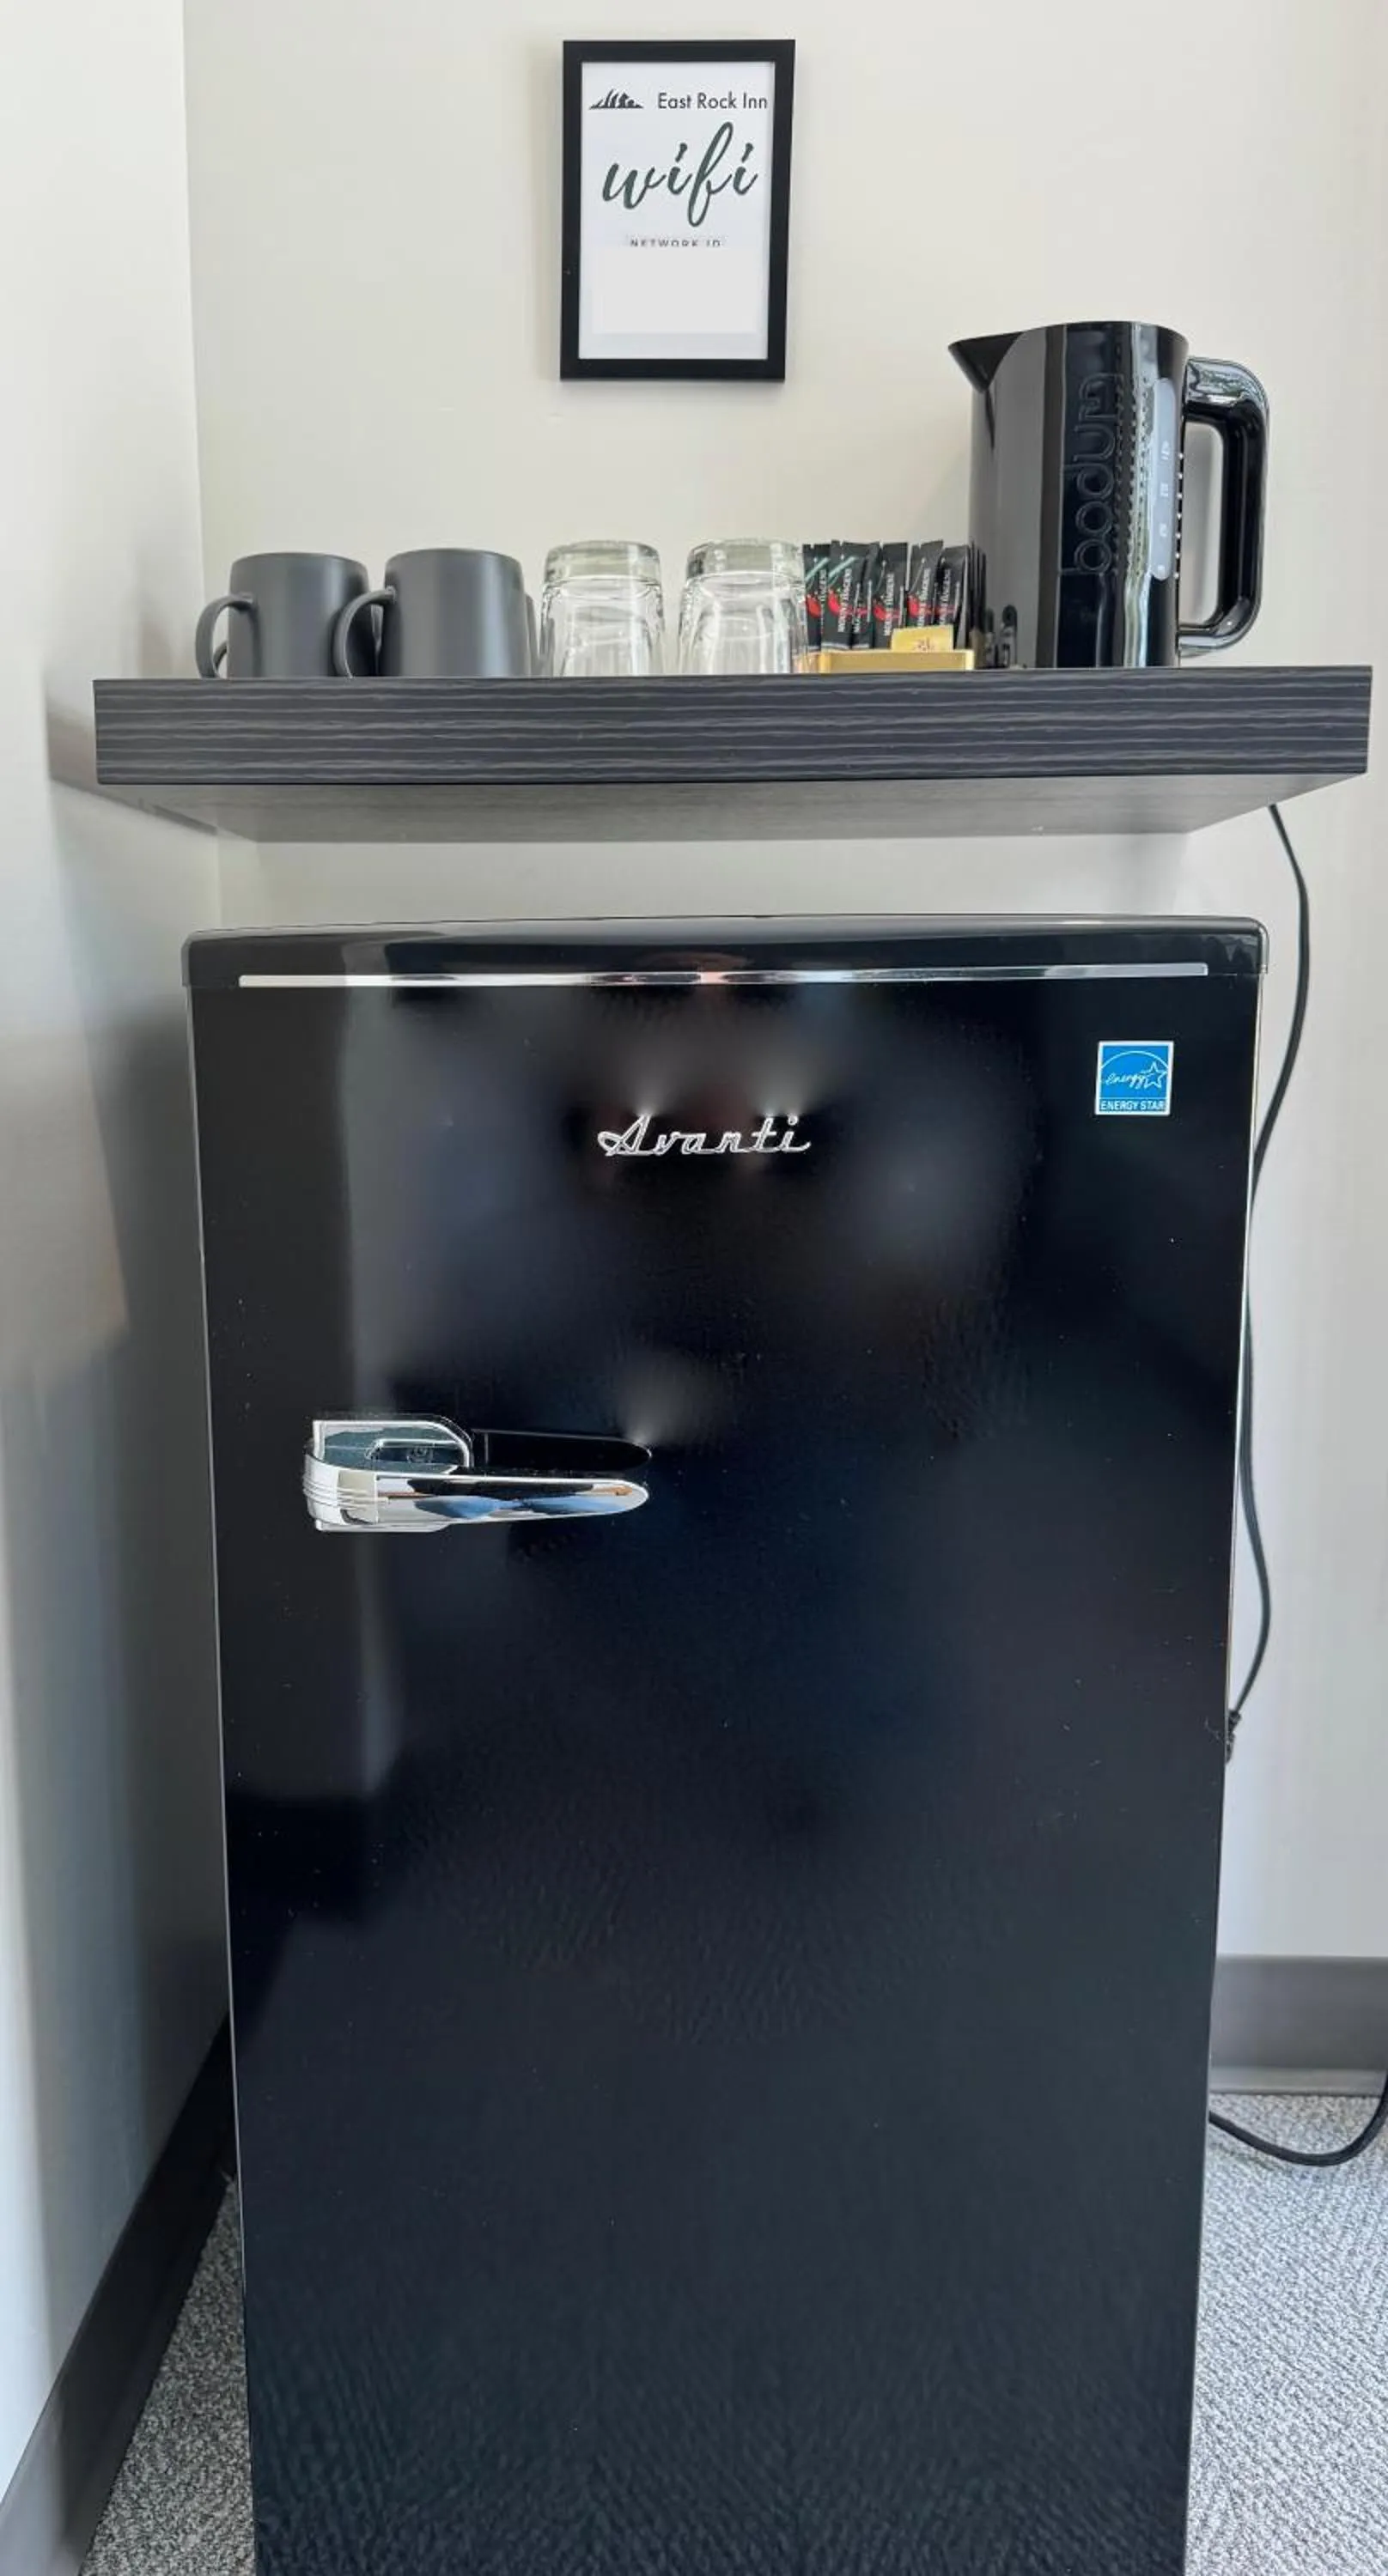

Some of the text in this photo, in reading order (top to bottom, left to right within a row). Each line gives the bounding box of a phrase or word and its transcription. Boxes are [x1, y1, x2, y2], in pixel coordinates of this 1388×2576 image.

[657, 91, 768, 110] East Rock Inn
[602, 121, 758, 228] wifi
[1061, 373, 1123, 574] bodum
[1100, 1100, 1165, 1110] ENERGY STAR
[597, 1113, 812, 1157] Avanti
